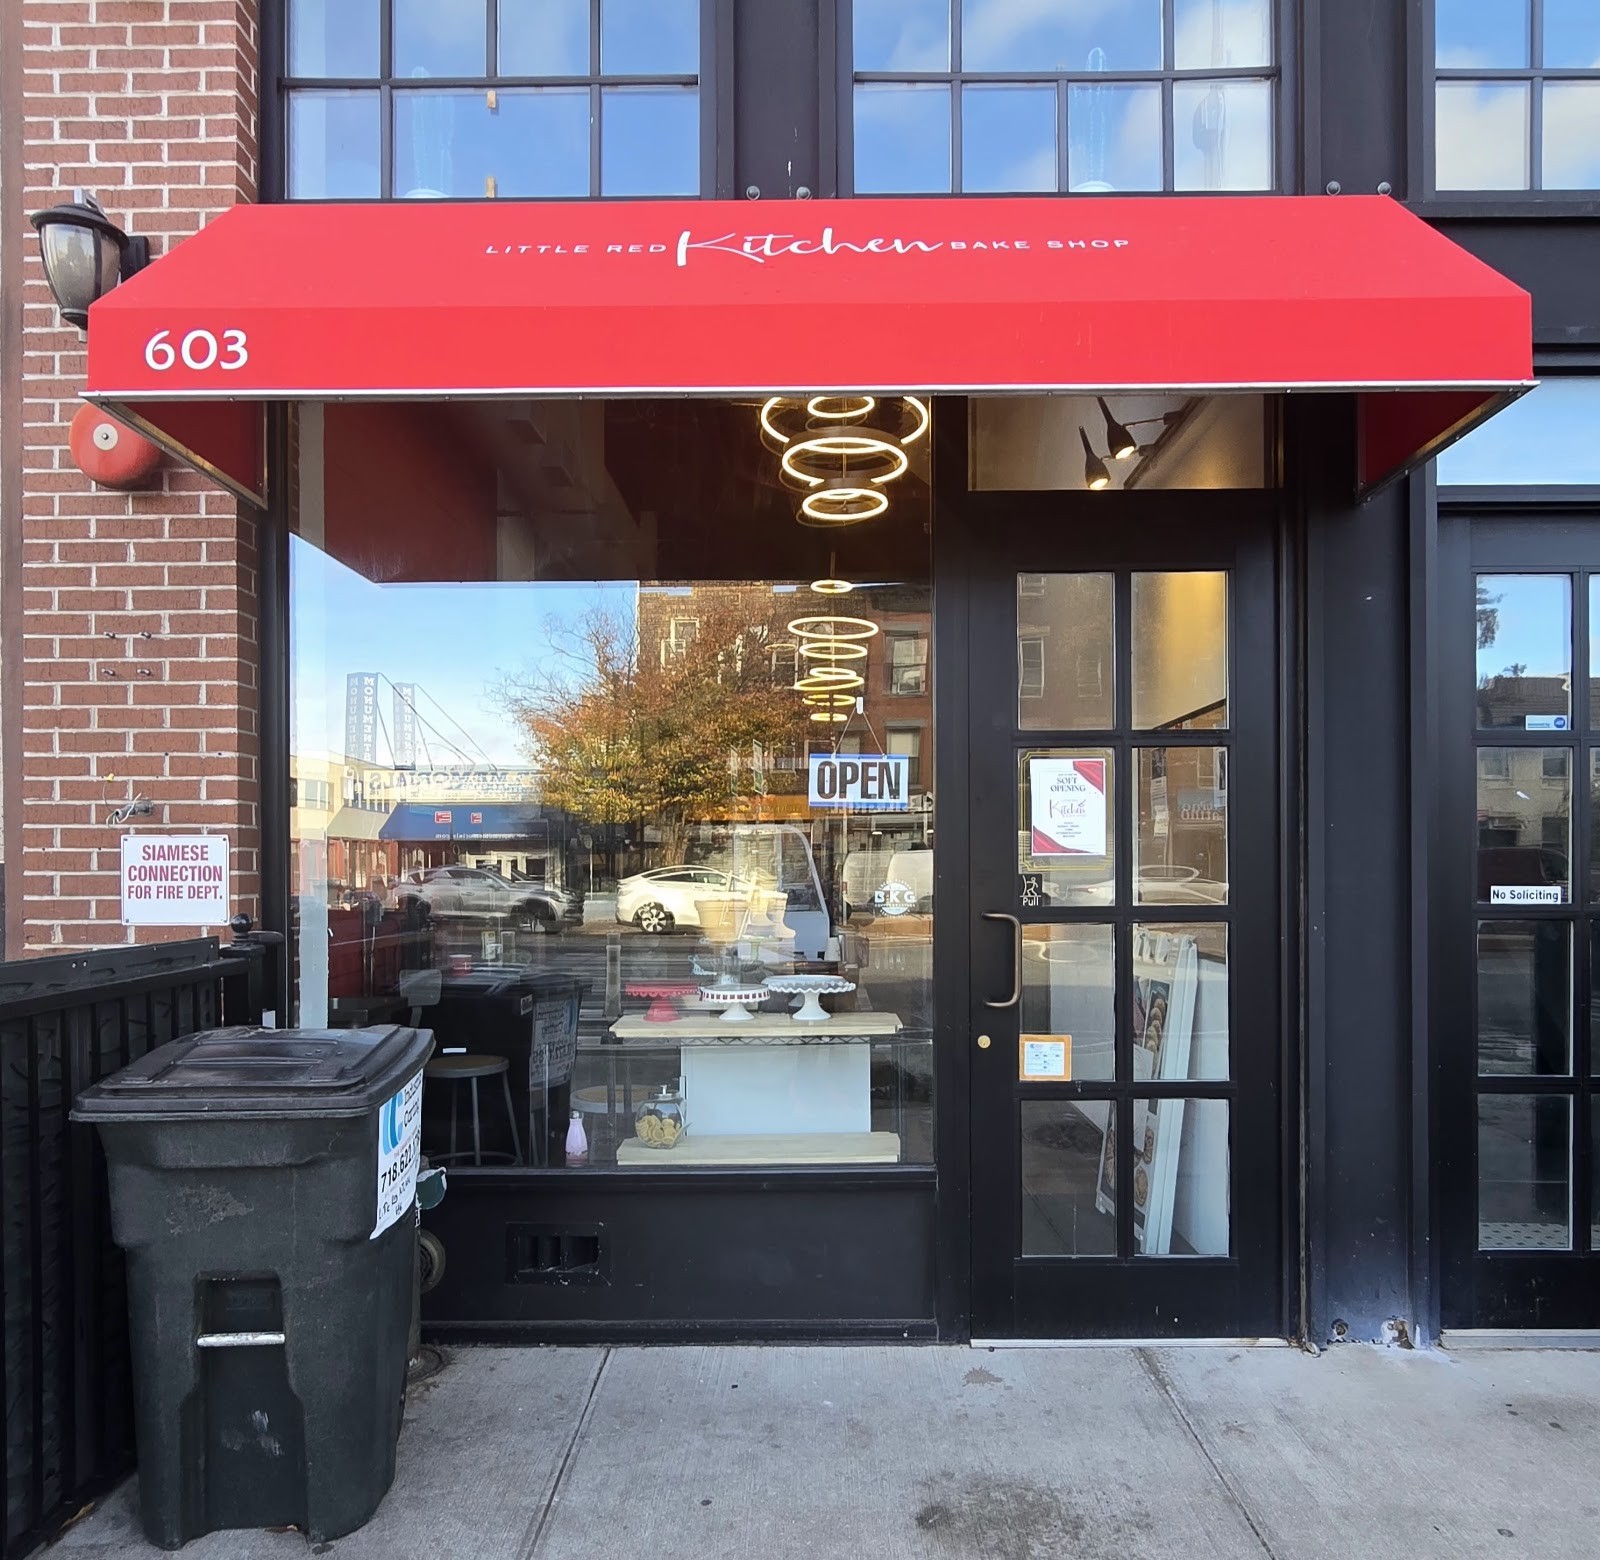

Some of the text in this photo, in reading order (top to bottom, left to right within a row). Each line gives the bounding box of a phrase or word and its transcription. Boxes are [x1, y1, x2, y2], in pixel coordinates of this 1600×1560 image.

[485, 227, 1129, 267] LITTLE RED Kitchen BAKE SHOP
[144, 328, 249, 371] 603
[816, 760, 901, 800] OPEN
[1056, 776, 1078, 785] SOFT
[1050, 785, 1086, 793] OPENING
[141, 844, 209, 862] SIAMESE
[127, 864, 223, 882] CONNECTION
[127, 885, 223, 900] FOR FIRE DEPT.
[1492, 889, 1559, 903] No Soliciting
[1022, 896, 1039, 907] Pull
